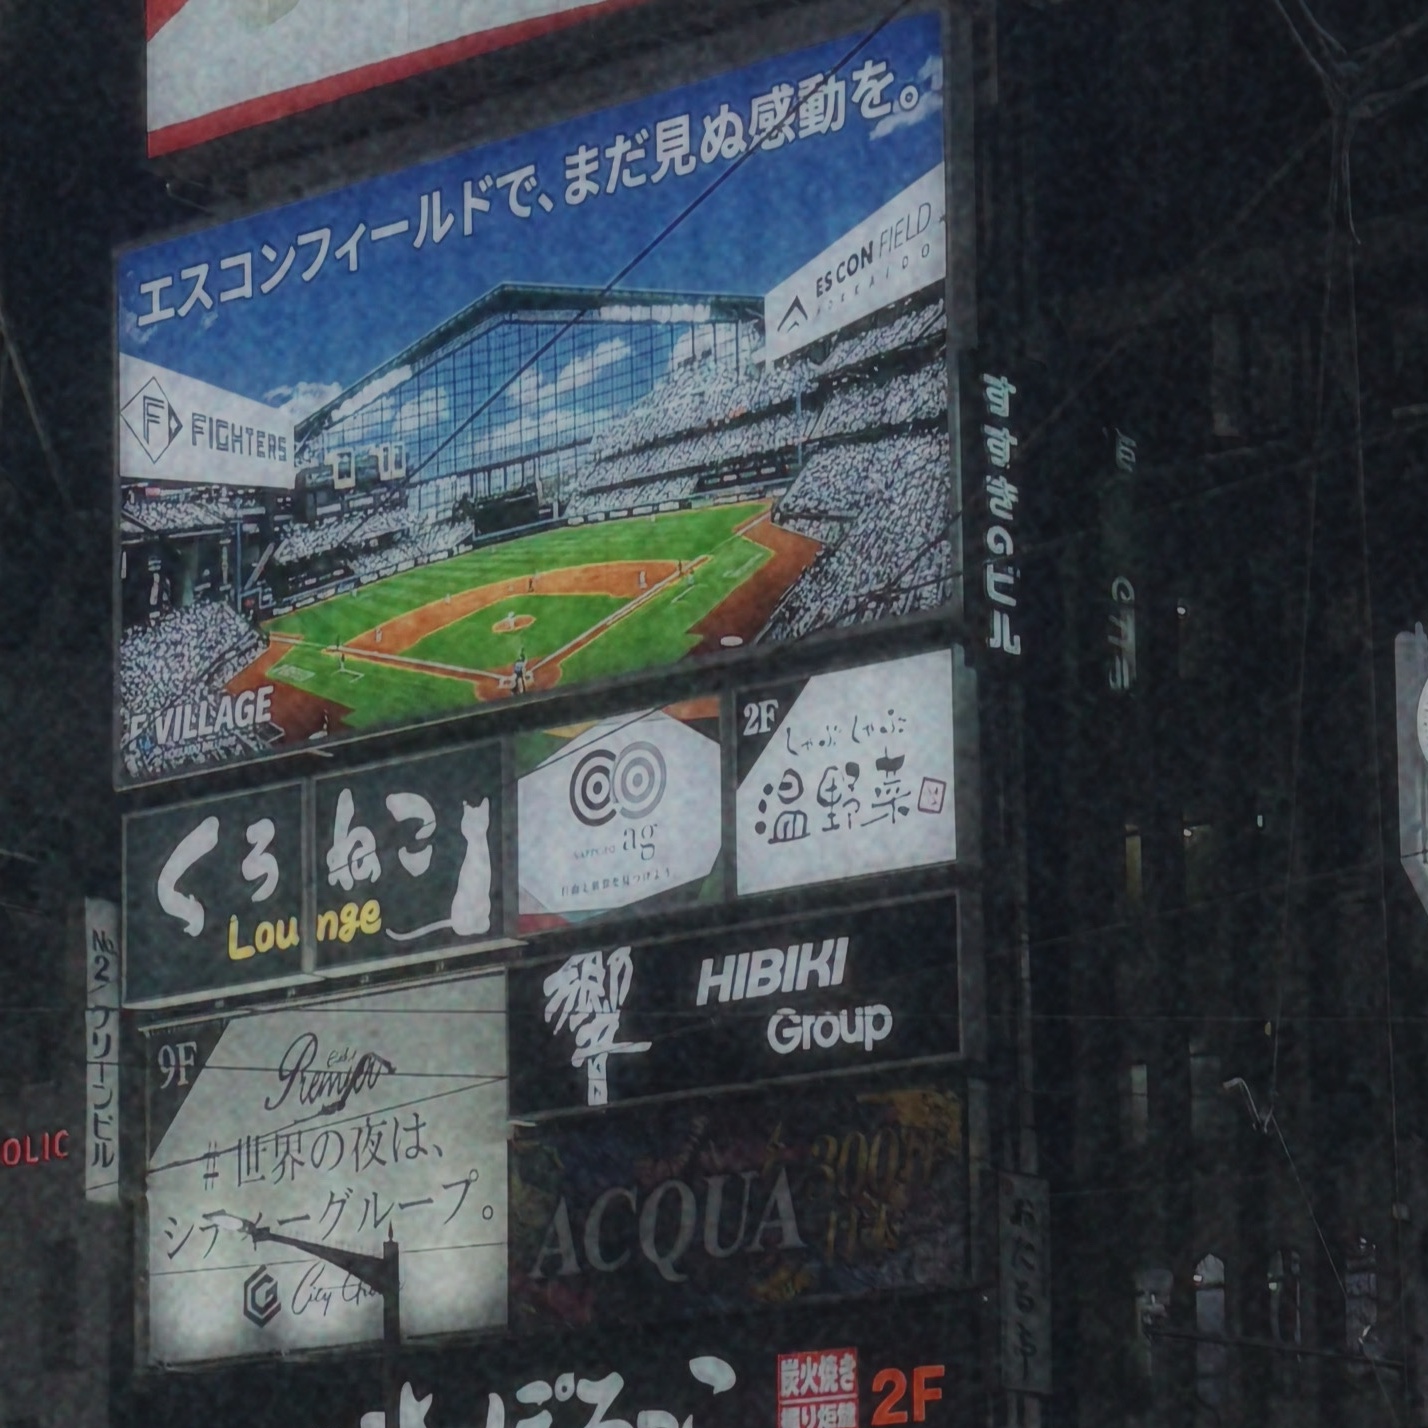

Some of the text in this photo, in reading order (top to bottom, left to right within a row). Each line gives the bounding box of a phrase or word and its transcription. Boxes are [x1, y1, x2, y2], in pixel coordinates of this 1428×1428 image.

[816, 202, 932, 298] ESCON FIELD
[191, 412, 287, 461] FIGHTERS
[155, 685, 274, 745] VILLAGE
[743, 699, 779, 737] 2F
[157, 787, 437, 937] くろねこ
[227, 899, 382, 961] Lounge
[696, 937, 850, 1006] HIBIKI
[767, 1003, 893, 1054] Group
[157, 1041, 198, 1090] 9F
[528, 1167, 806, 1282] ACQUA
[781, 1352, 857, 1398] 炭火焼き
[871, 1364, 945, 1426] 2F
